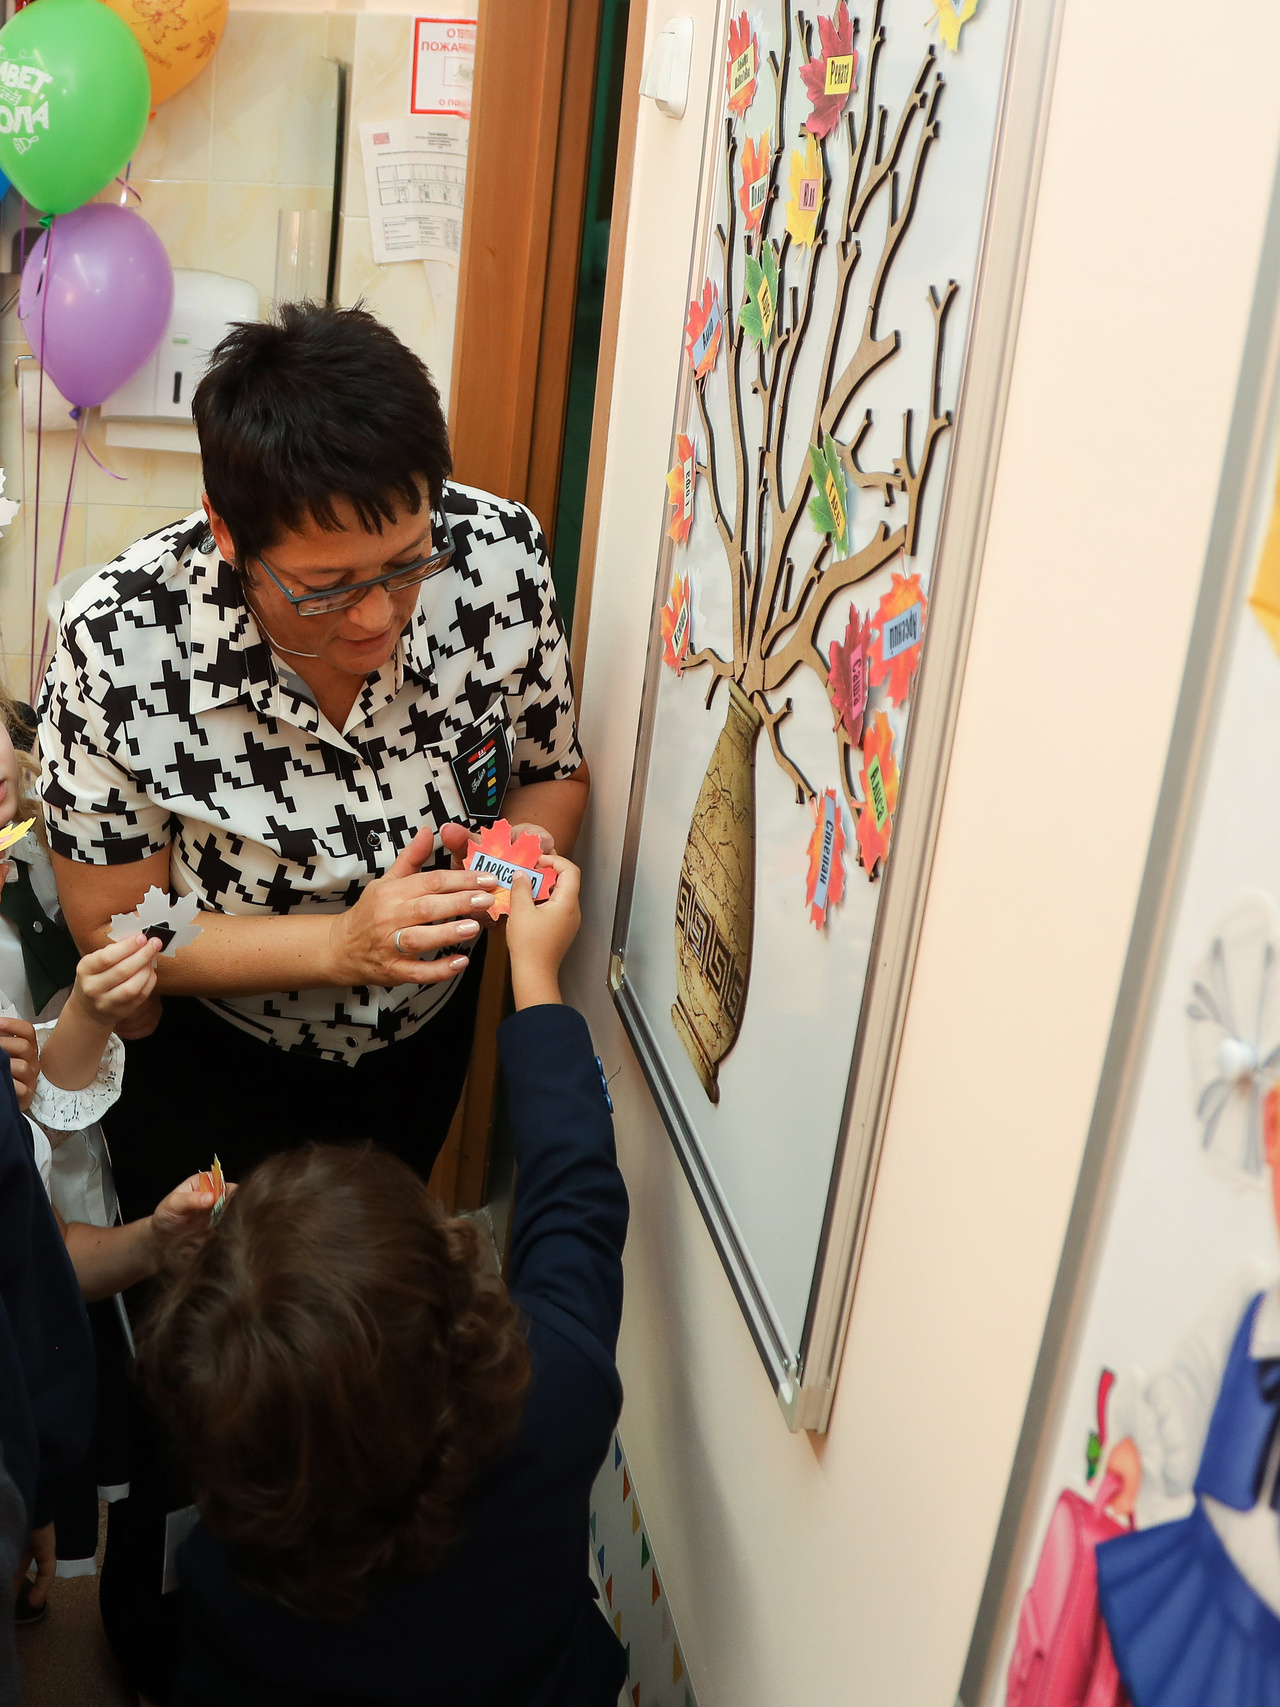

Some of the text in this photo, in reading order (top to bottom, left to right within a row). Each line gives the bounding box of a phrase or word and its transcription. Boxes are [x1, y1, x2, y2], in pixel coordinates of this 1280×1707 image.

[889, 610, 918, 656] Арсений
[852, 658, 862, 707] Саша
[870, 766, 885, 823] Алиса
[475, 855, 537, 890] Алексар
[819, 819, 834, 886] Степан
